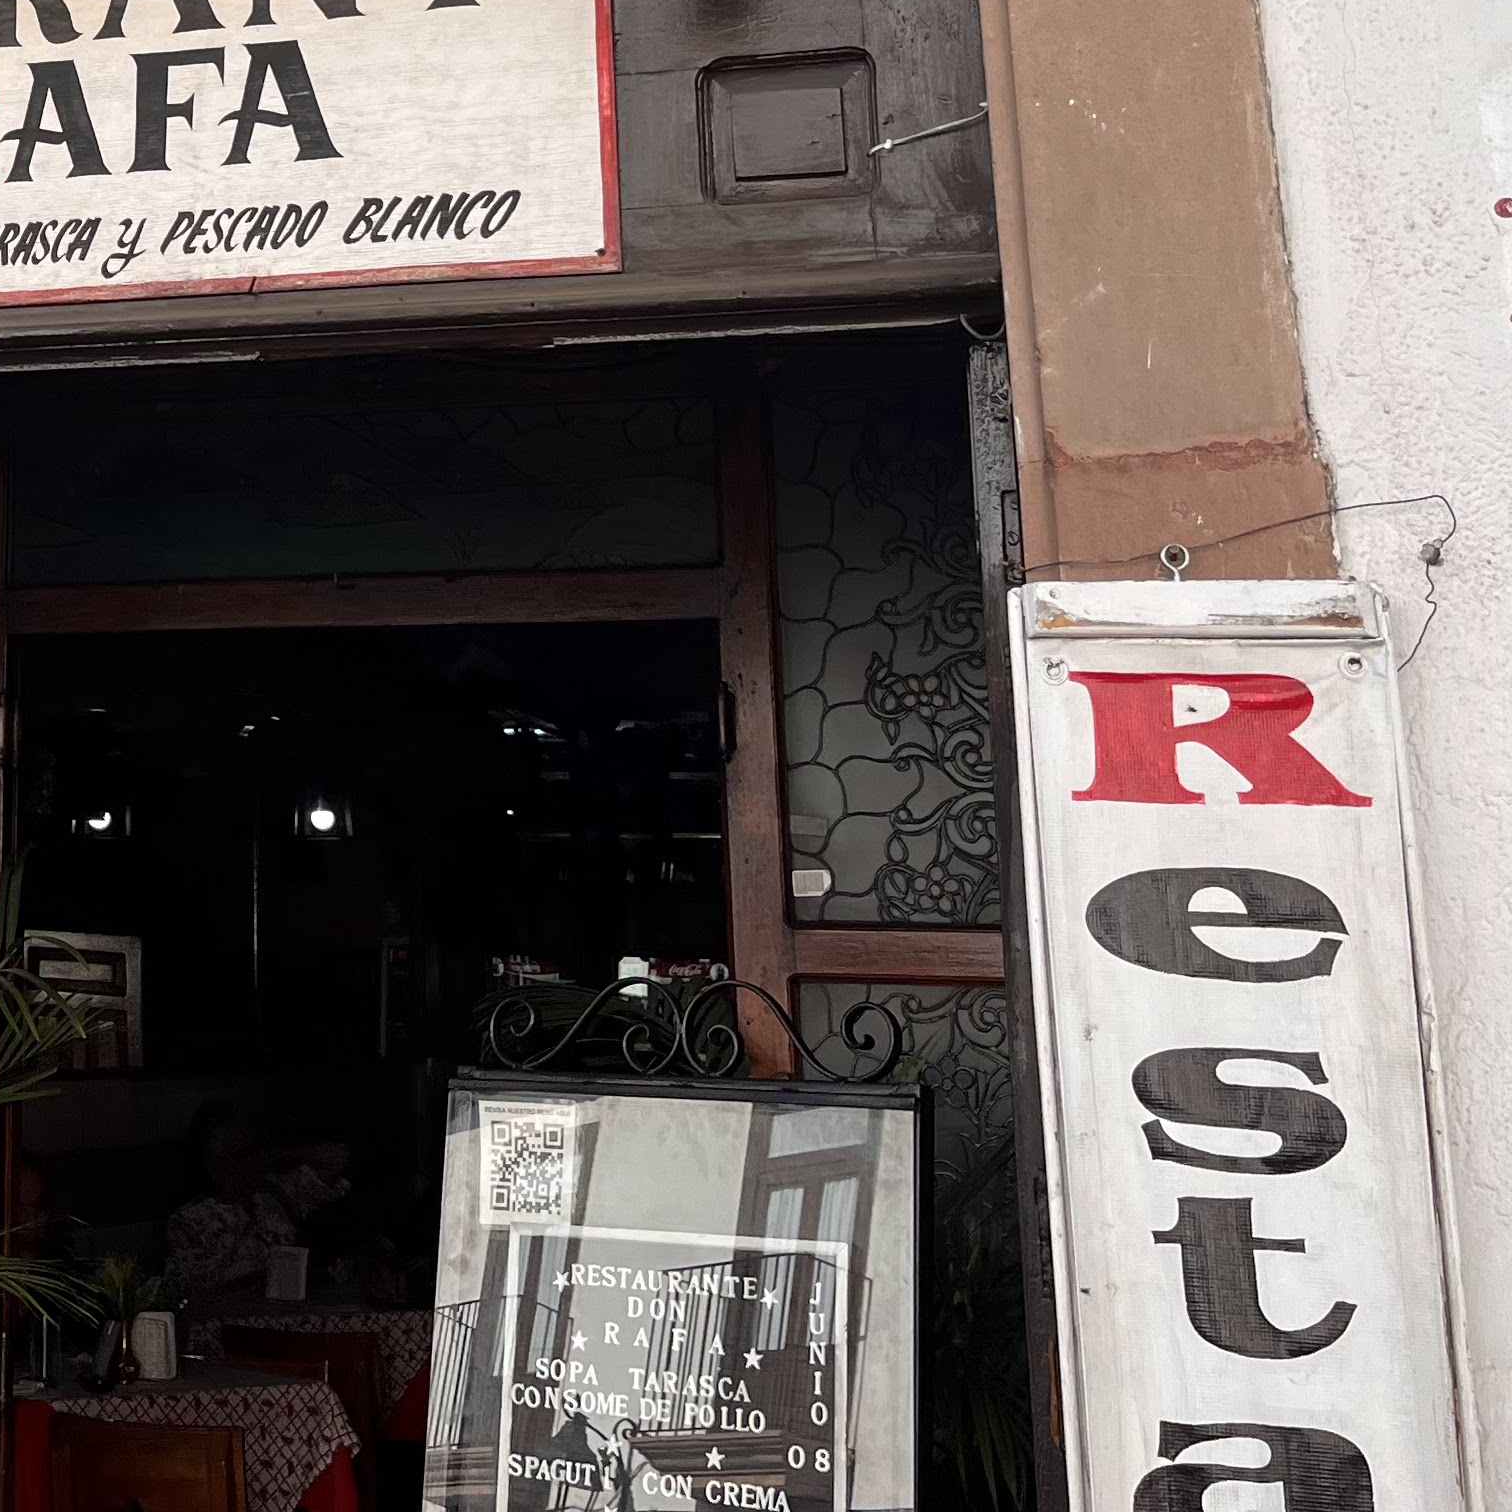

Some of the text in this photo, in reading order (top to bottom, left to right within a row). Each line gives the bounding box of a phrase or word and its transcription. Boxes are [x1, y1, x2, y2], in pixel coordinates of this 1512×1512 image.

[159, 200, 329, 257] PESCADO
[341, 189, 521, 245] BLANCO
[571, 1263, 758, 1300] RESTAURANTE
[627, 1296, 685, 1322] DON
[535, 1358, 751, 1403] SOPA TARASCA
[511, 1383, 766, 1433] CONSOME DE POLLO
[642, 1472, 694, 1500] CON
[705, 1481, 791, 1512] CREMA
